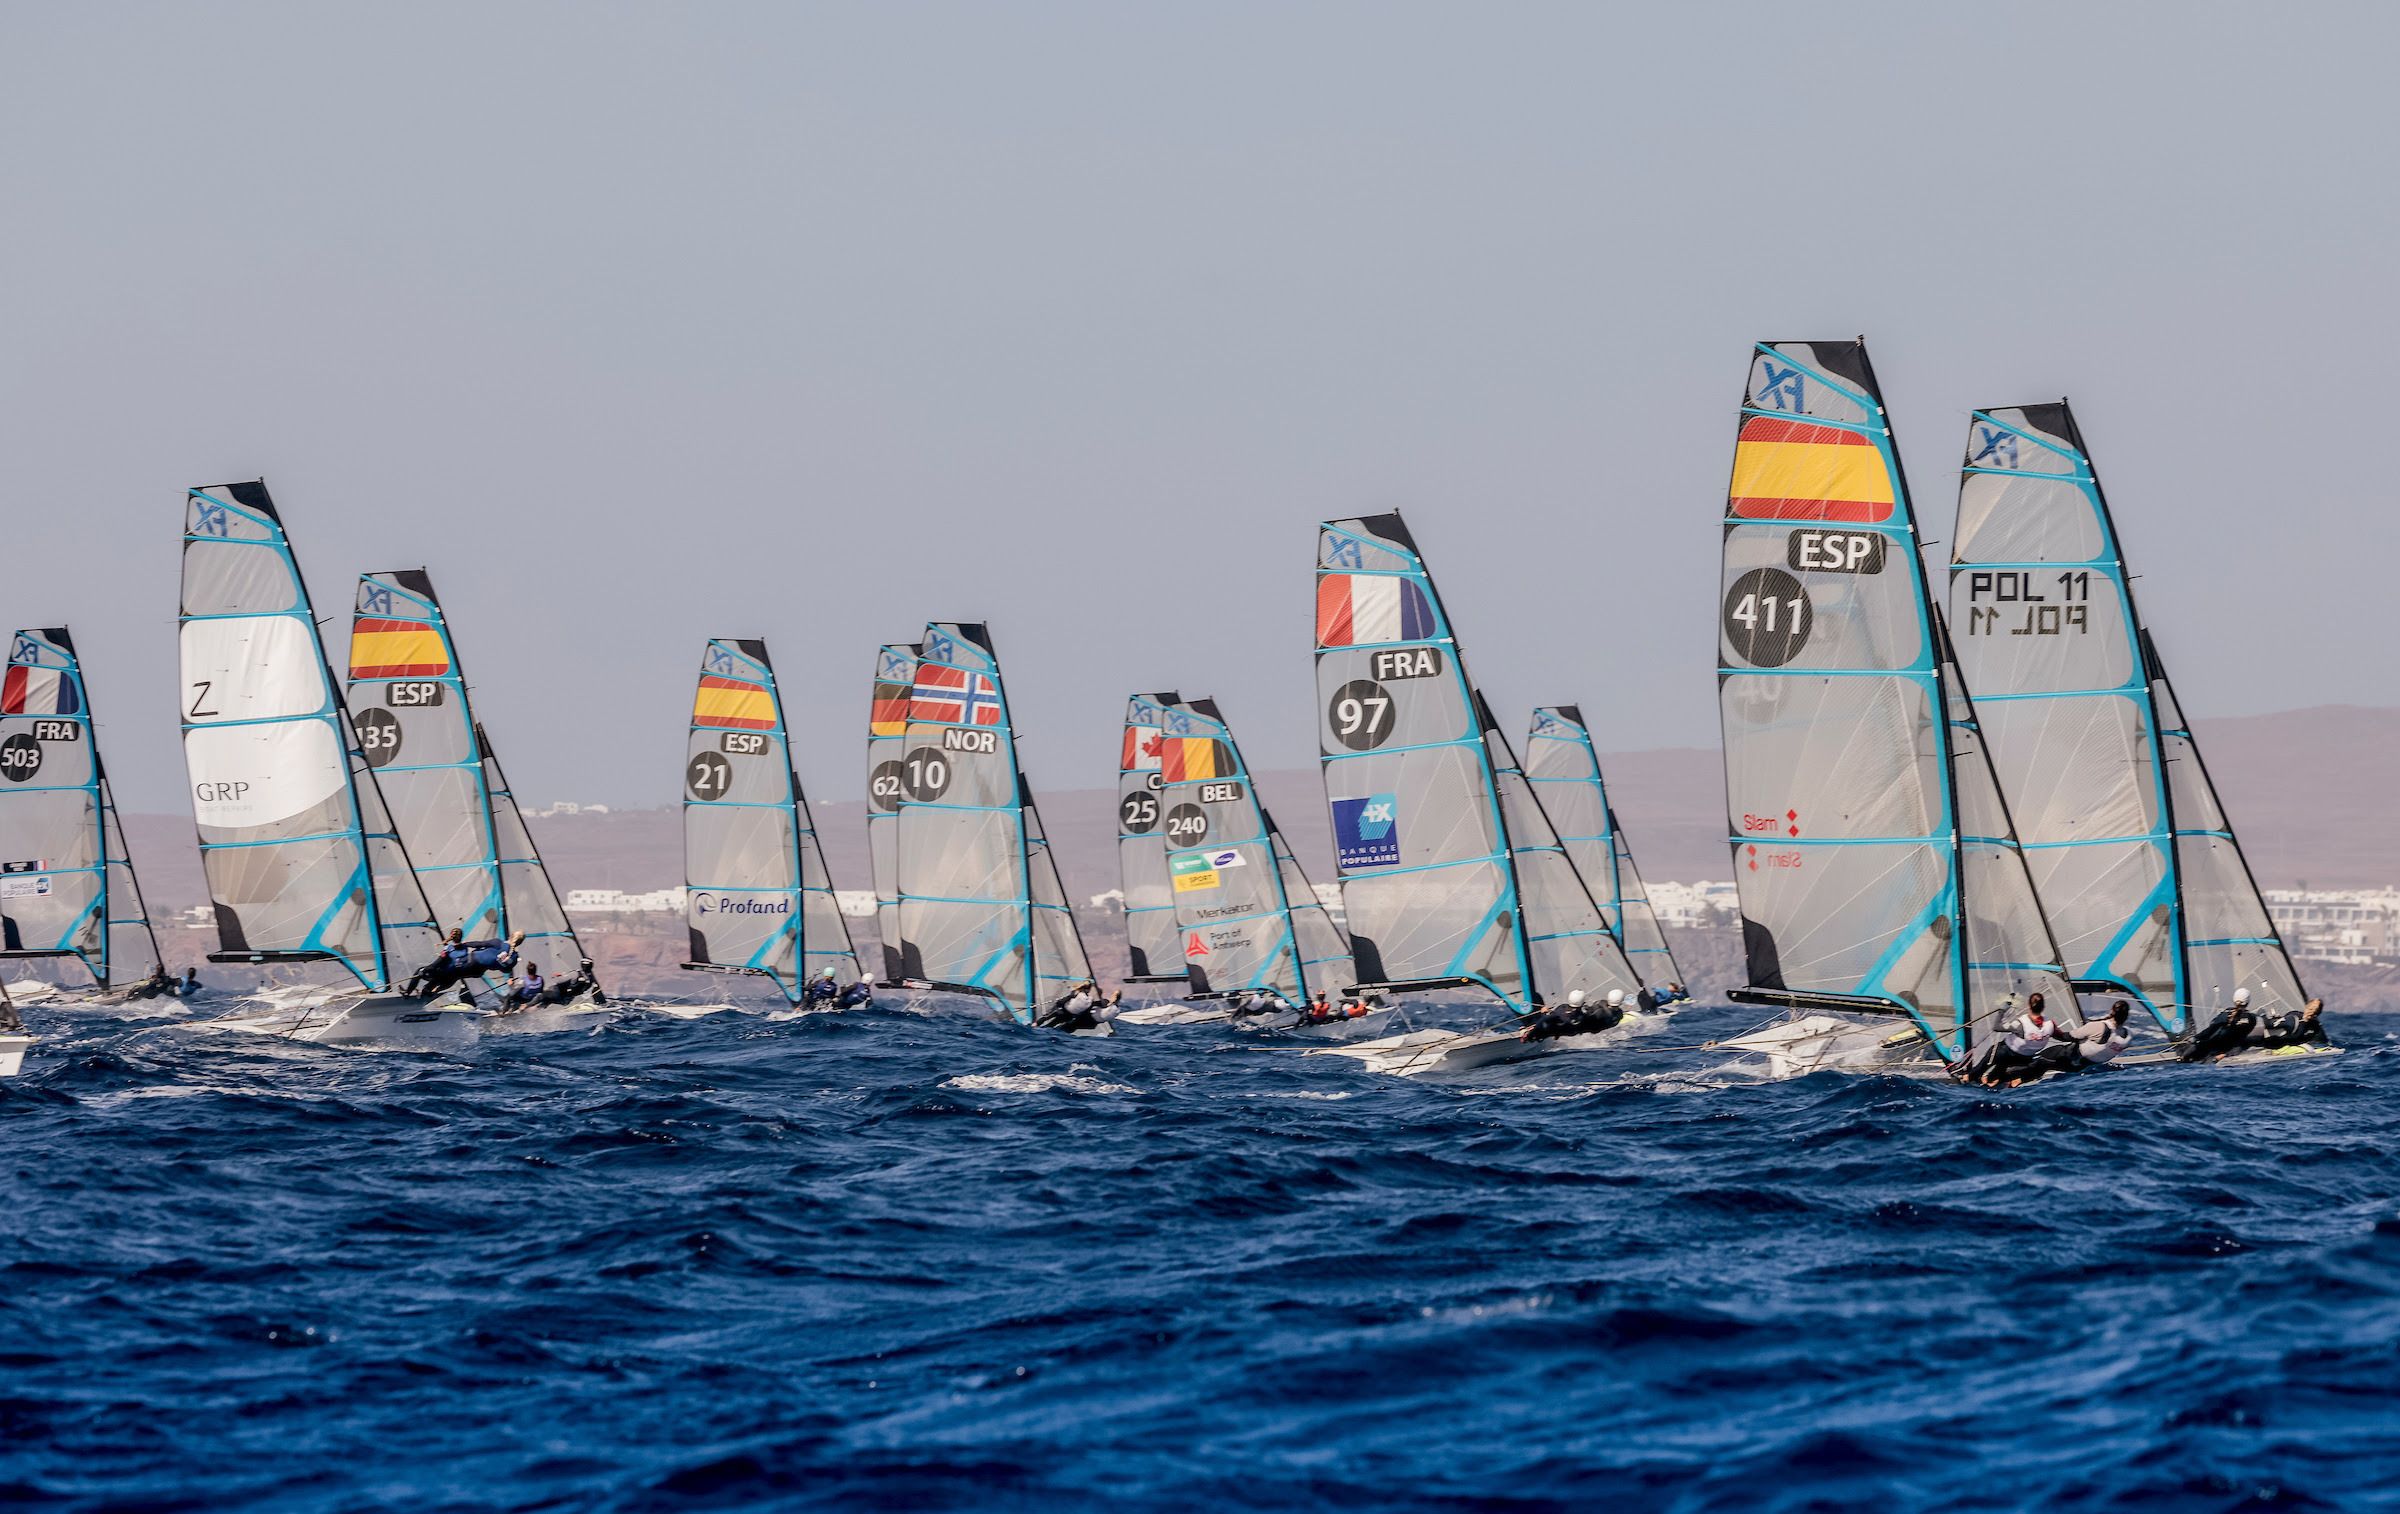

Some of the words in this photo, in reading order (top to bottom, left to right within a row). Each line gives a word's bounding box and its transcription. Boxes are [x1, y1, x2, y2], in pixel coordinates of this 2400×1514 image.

[1799, 533, 1872, 569] ESP
[1971, 572, 2044, 602] POL
[2057, 571, 2088, 601] 11
[1732, 593, 1804, 635] 411
[1377, 650, 1435, 680] FRA
[190, 681, 219, 717] Z
[391, 683, 437, 705] ESP
[1337, 698, 1389, 735] 97
[36, 722, 75, 741] FRA
[944, 729, 996, 754] NOR
[725, 733, 764, 753] ESP
[1, 748, 40, 769] 503
[694, 763, 727, 791] 21
[908, 759, 946, 790] 10
[196, 781, 249, 802] GRP
[872, 776, 900, 796] 62
[1203, 784, 1238, 803] BEL
[1125, 800, 1157, 825] 25
[1168, 816, 1207, 836] 240
[1340, 844, 1396, 856] BANQUE
[1341, 853, 1399, 866] POPULAIRE
[719, 897, 789, 914] Profand
[1197, 902, 1255, 919] Merkator
